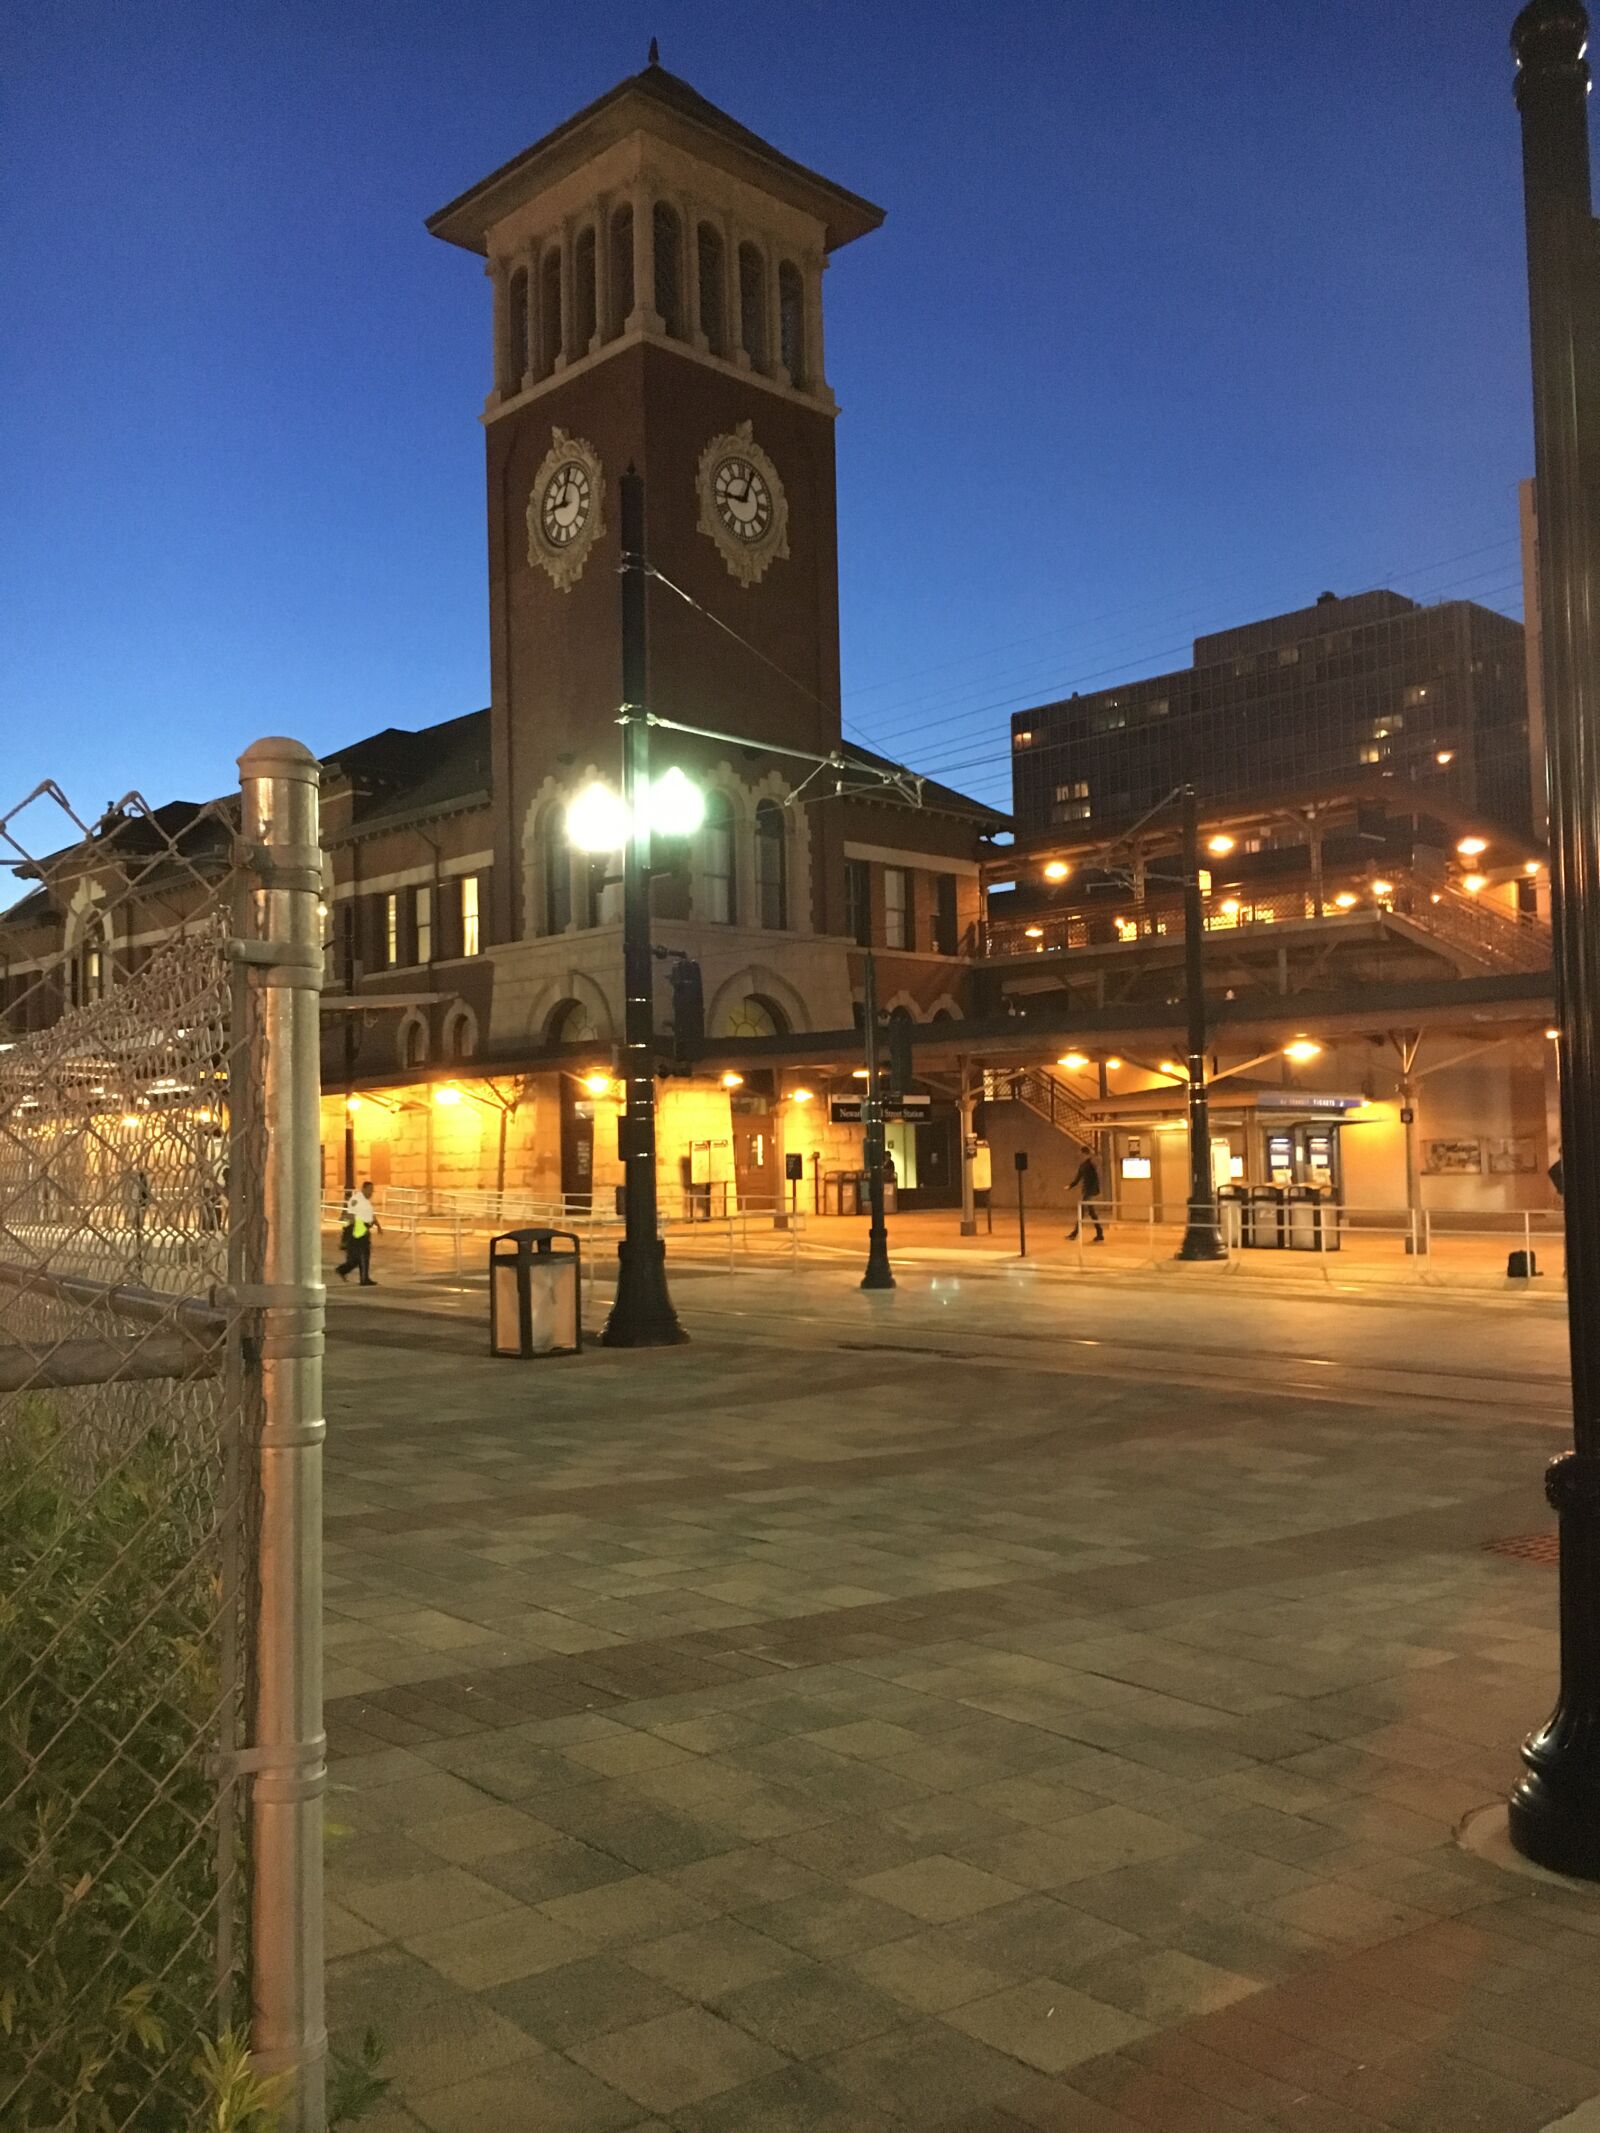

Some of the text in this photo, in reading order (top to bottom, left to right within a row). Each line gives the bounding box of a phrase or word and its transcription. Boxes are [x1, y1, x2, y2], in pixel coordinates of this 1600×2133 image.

[840, 1107, 861, 1118] Newar
[884, 1108, 902, 1118] Street
[903, 1108, 924, 1118] Station
